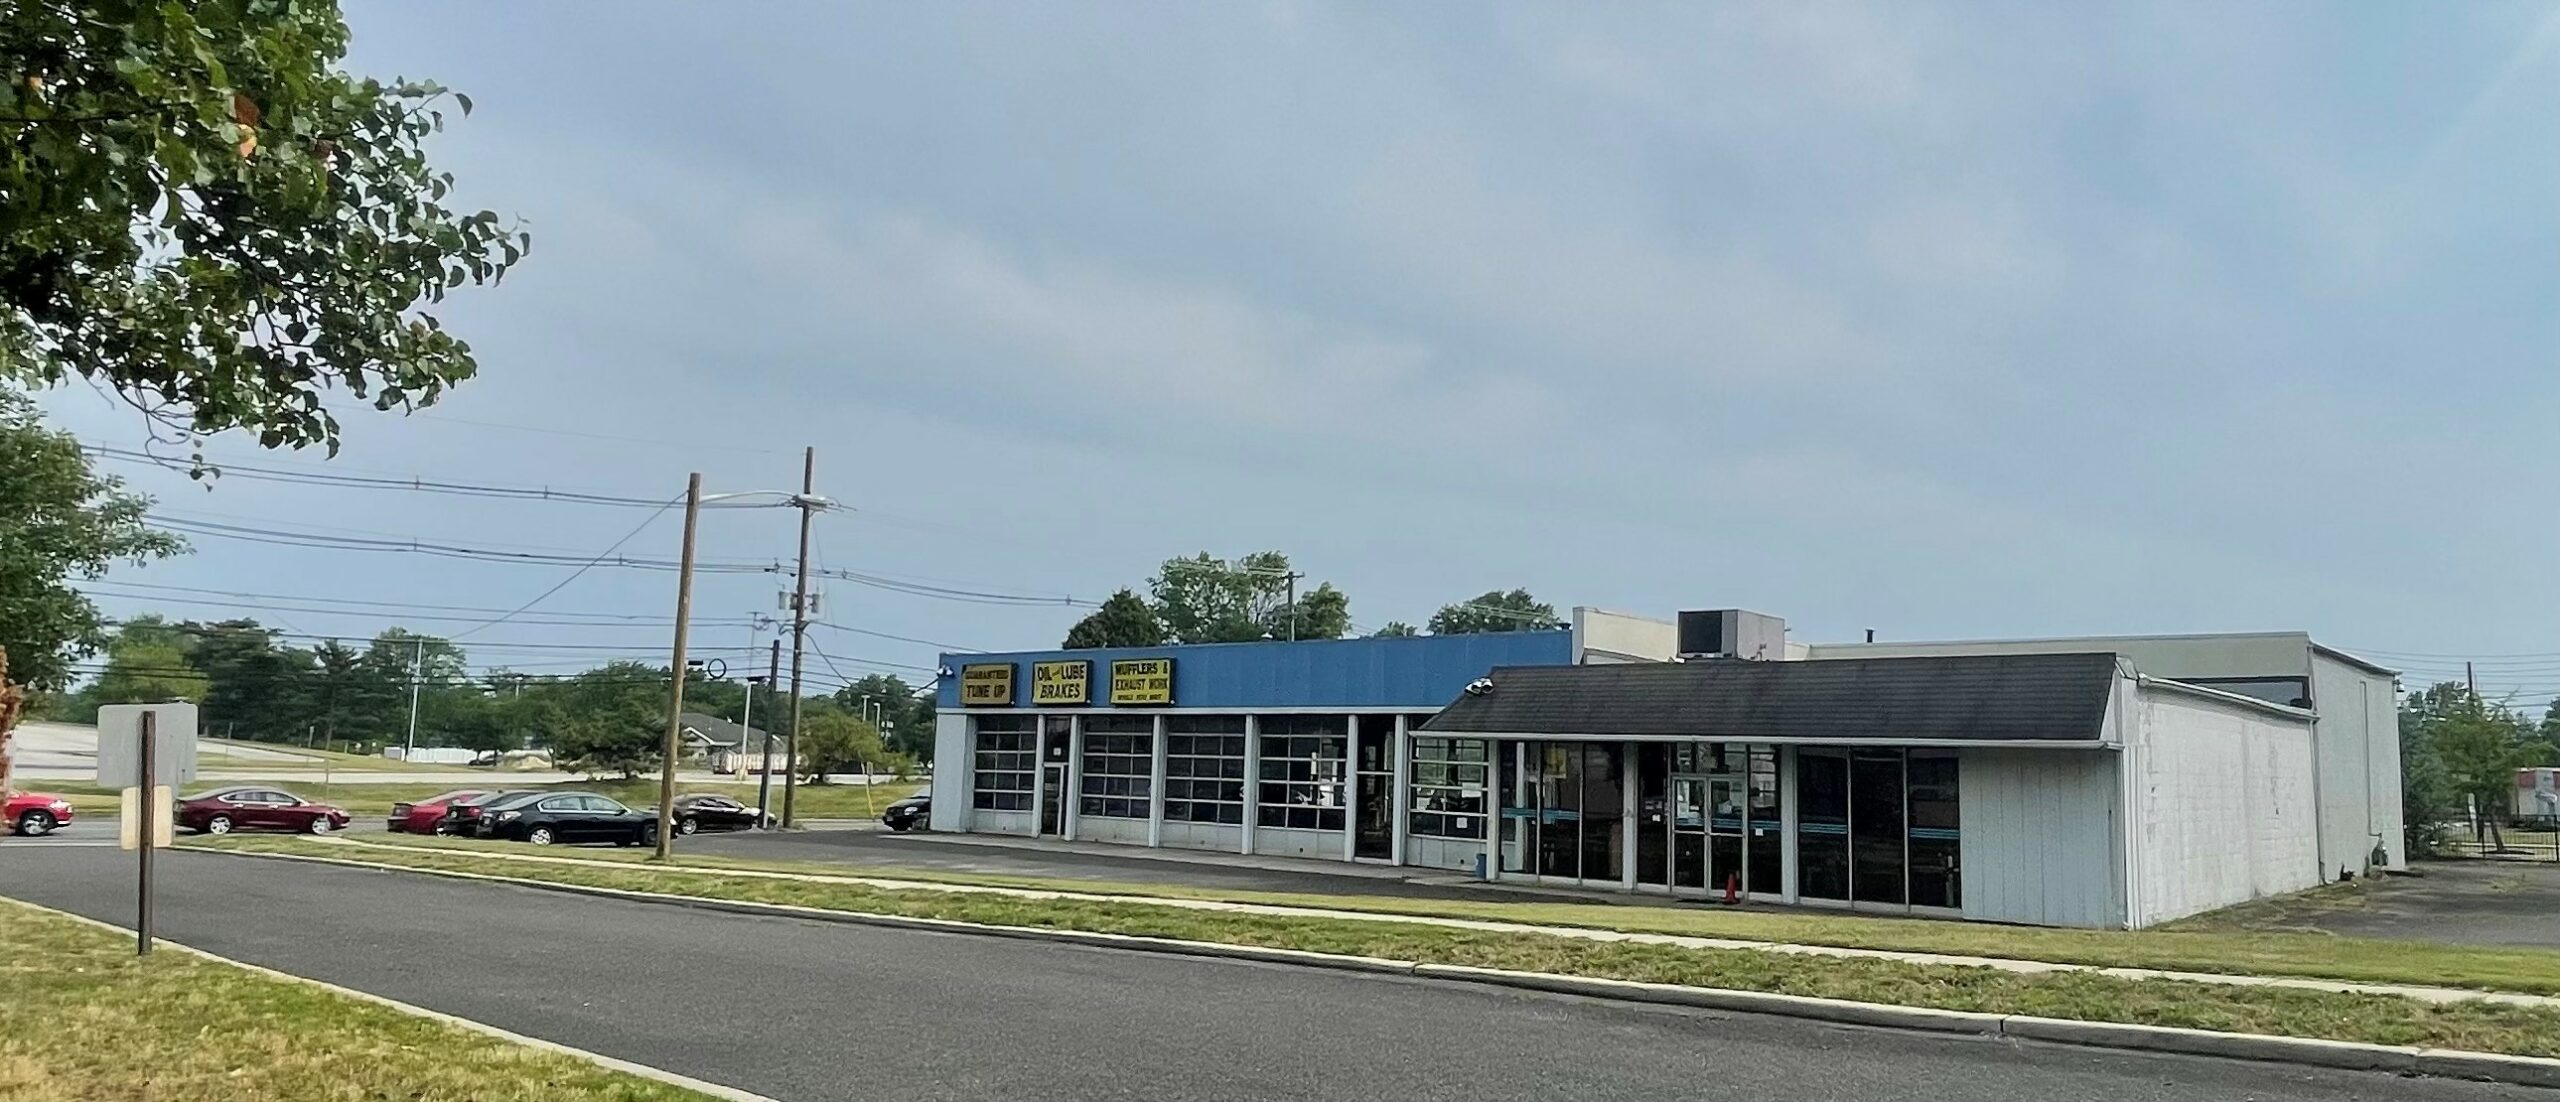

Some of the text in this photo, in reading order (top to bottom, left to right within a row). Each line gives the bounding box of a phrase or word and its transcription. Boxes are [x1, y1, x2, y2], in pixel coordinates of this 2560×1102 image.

[1037, 666, 1053, 681] OIL
[1060, 665, 1086, 680] LUBE
[1115, 663, 1158, 675] MUFFLERS
[1115, 678, 1168, 691] EXHAUST WORK
[967, 685, 1007, 698] TUNE UP
[1040, 684, 1081, 699] BRAKES
